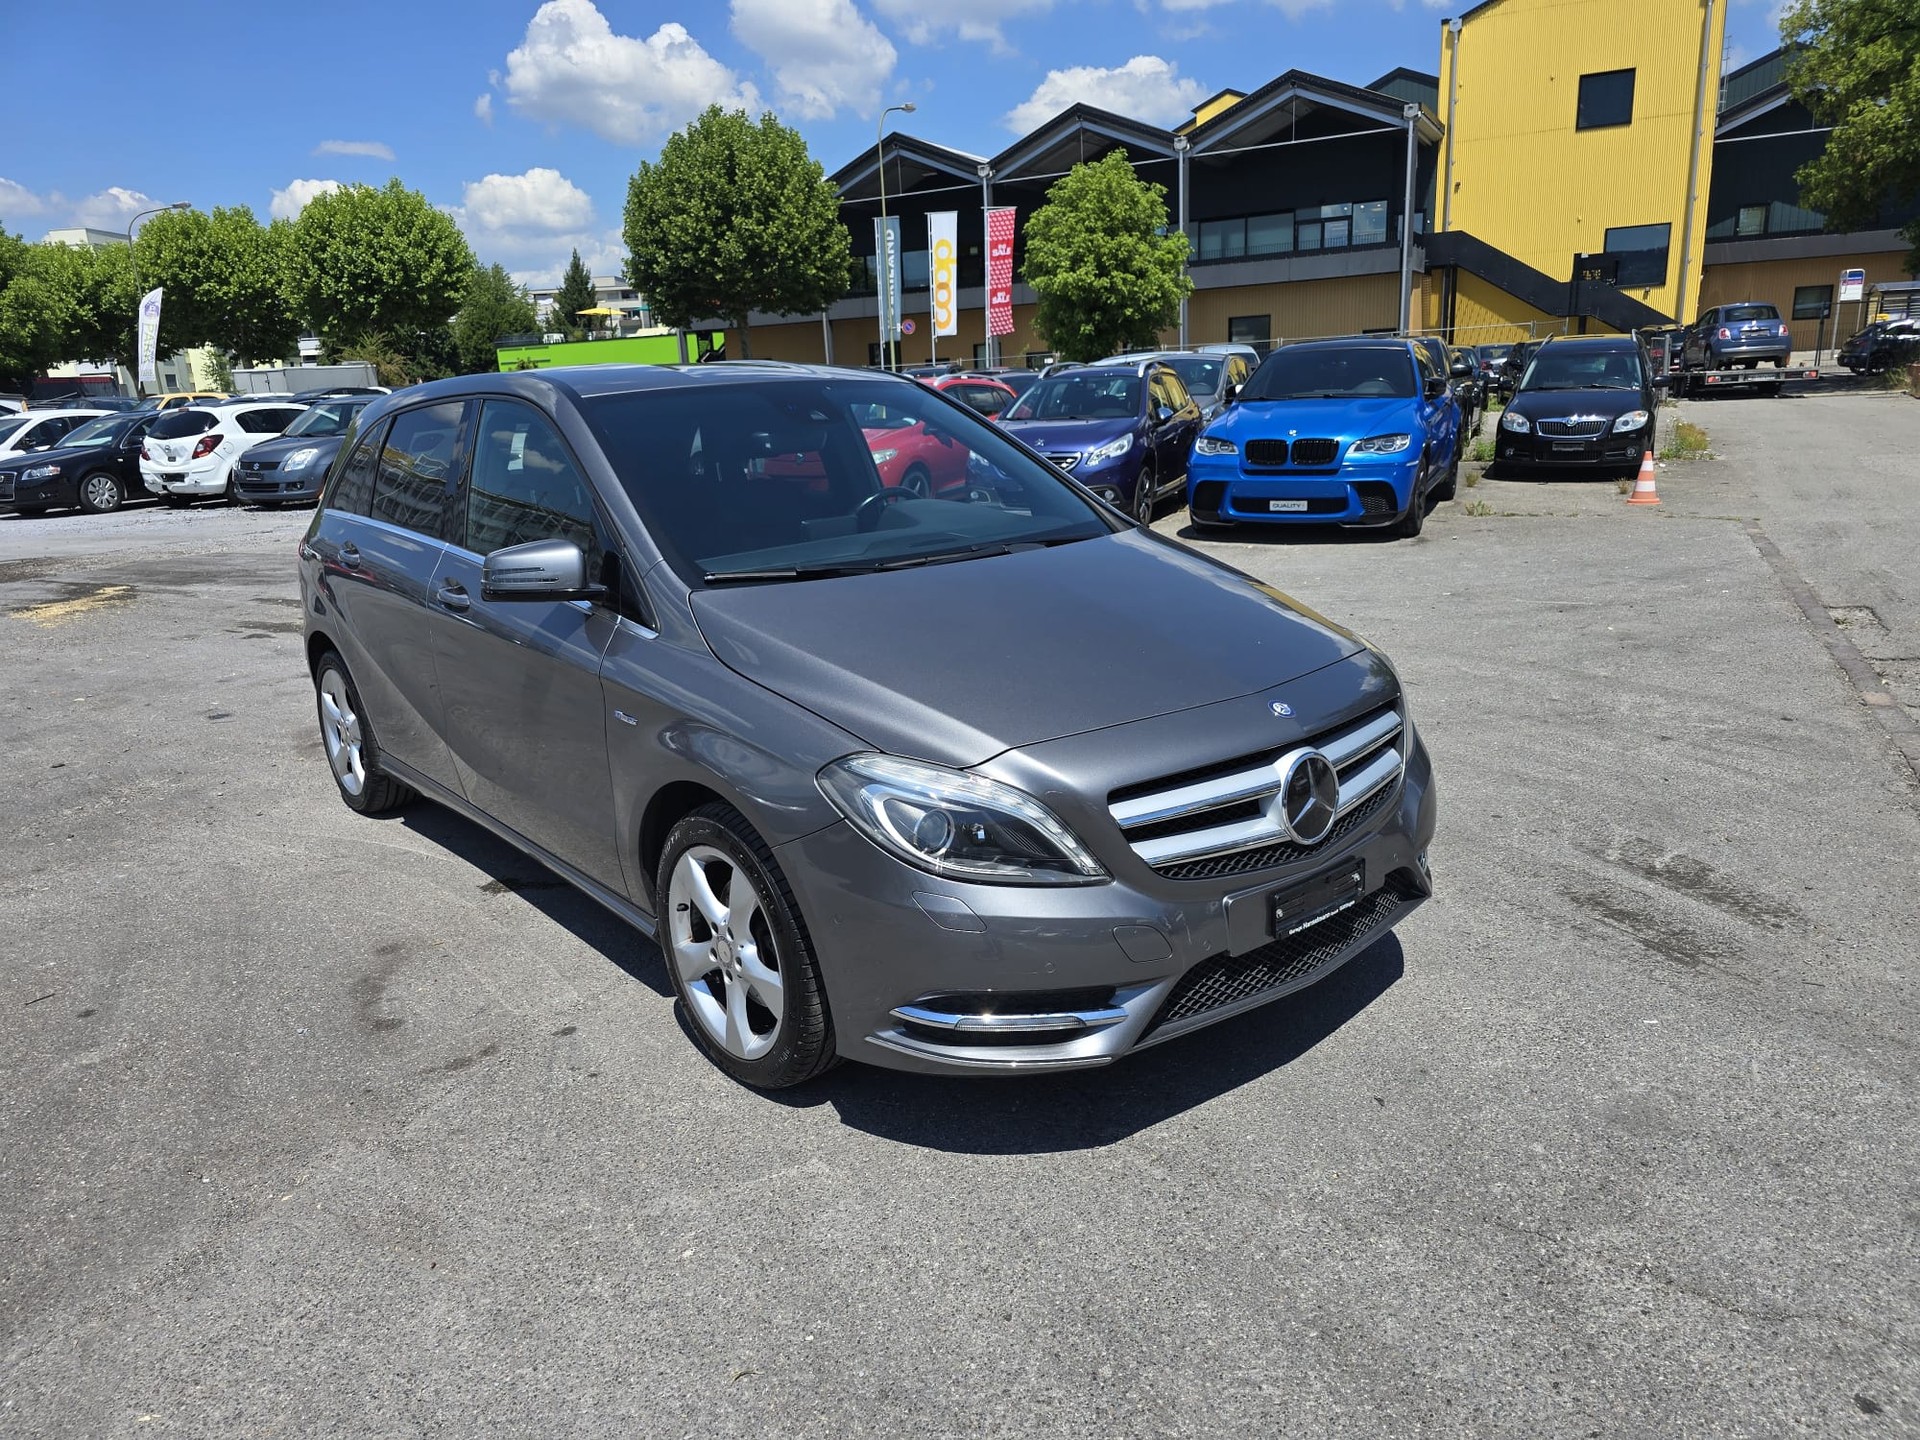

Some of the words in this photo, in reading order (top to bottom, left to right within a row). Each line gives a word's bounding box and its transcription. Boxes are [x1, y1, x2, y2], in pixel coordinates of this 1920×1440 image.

[992, 246, 1011, 257] SALE
[934, 239, 957, 330] coop
[992, 294, 1010, 304] SALE
